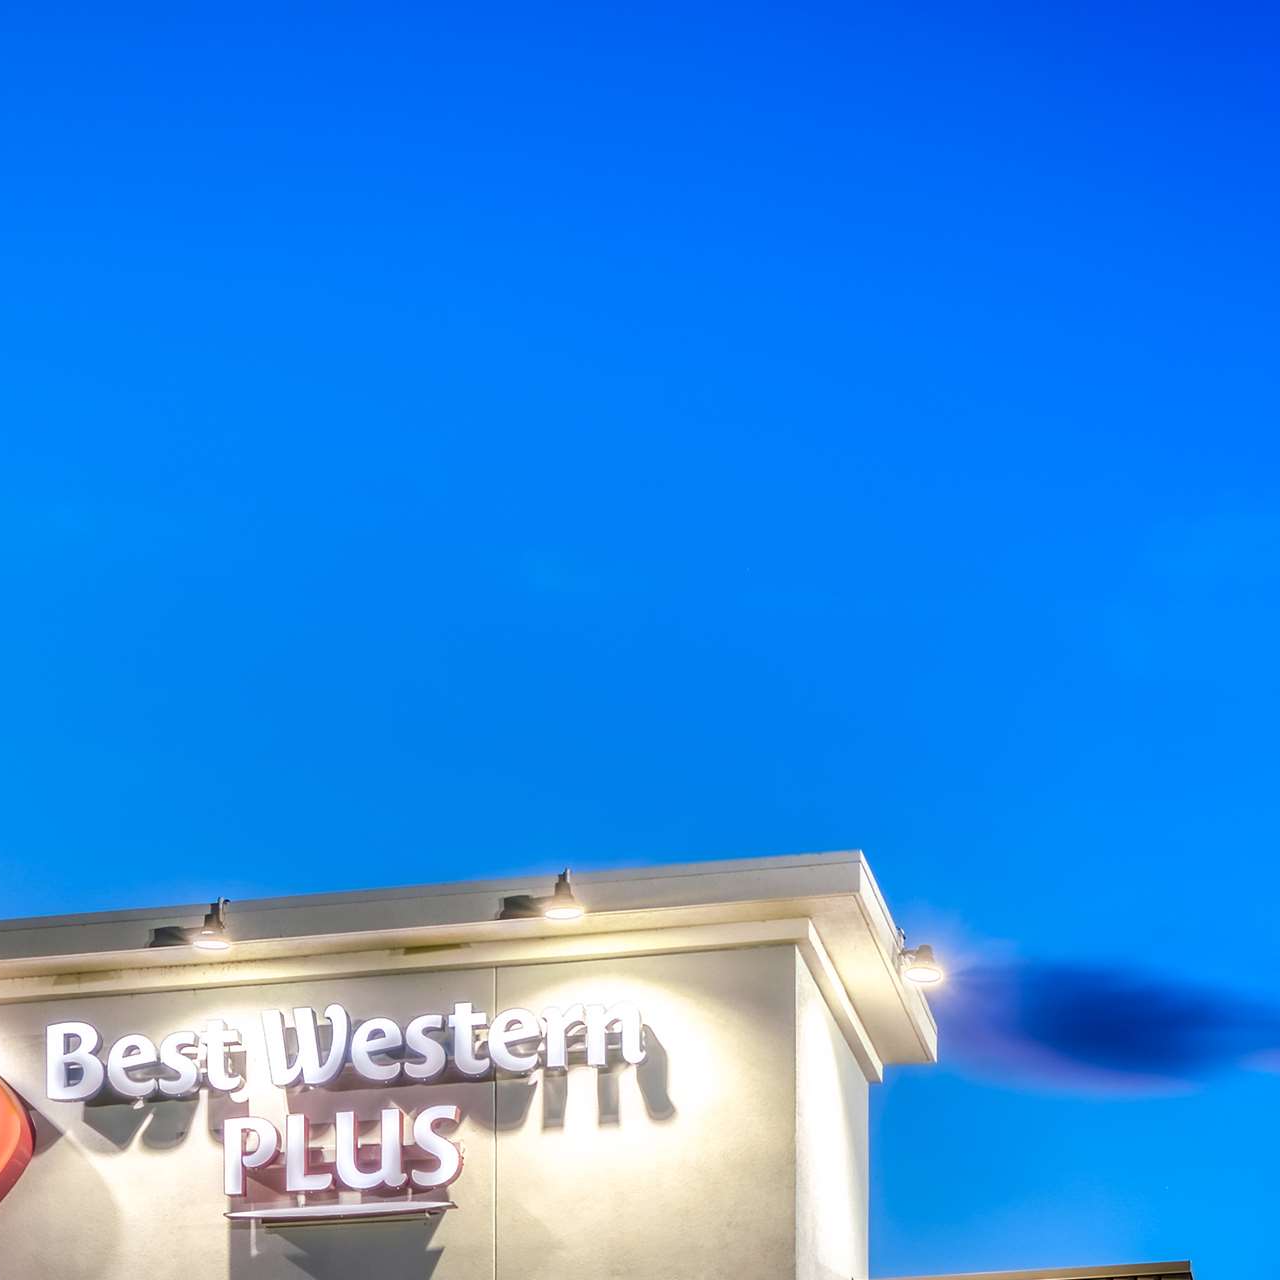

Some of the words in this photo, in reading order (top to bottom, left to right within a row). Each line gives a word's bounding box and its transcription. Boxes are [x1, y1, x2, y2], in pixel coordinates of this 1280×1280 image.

[46, 1019, 244, 1101] Best
[261, 1001, 646, 1087] Western
[223, 1104, 463, 1196] PLUS
